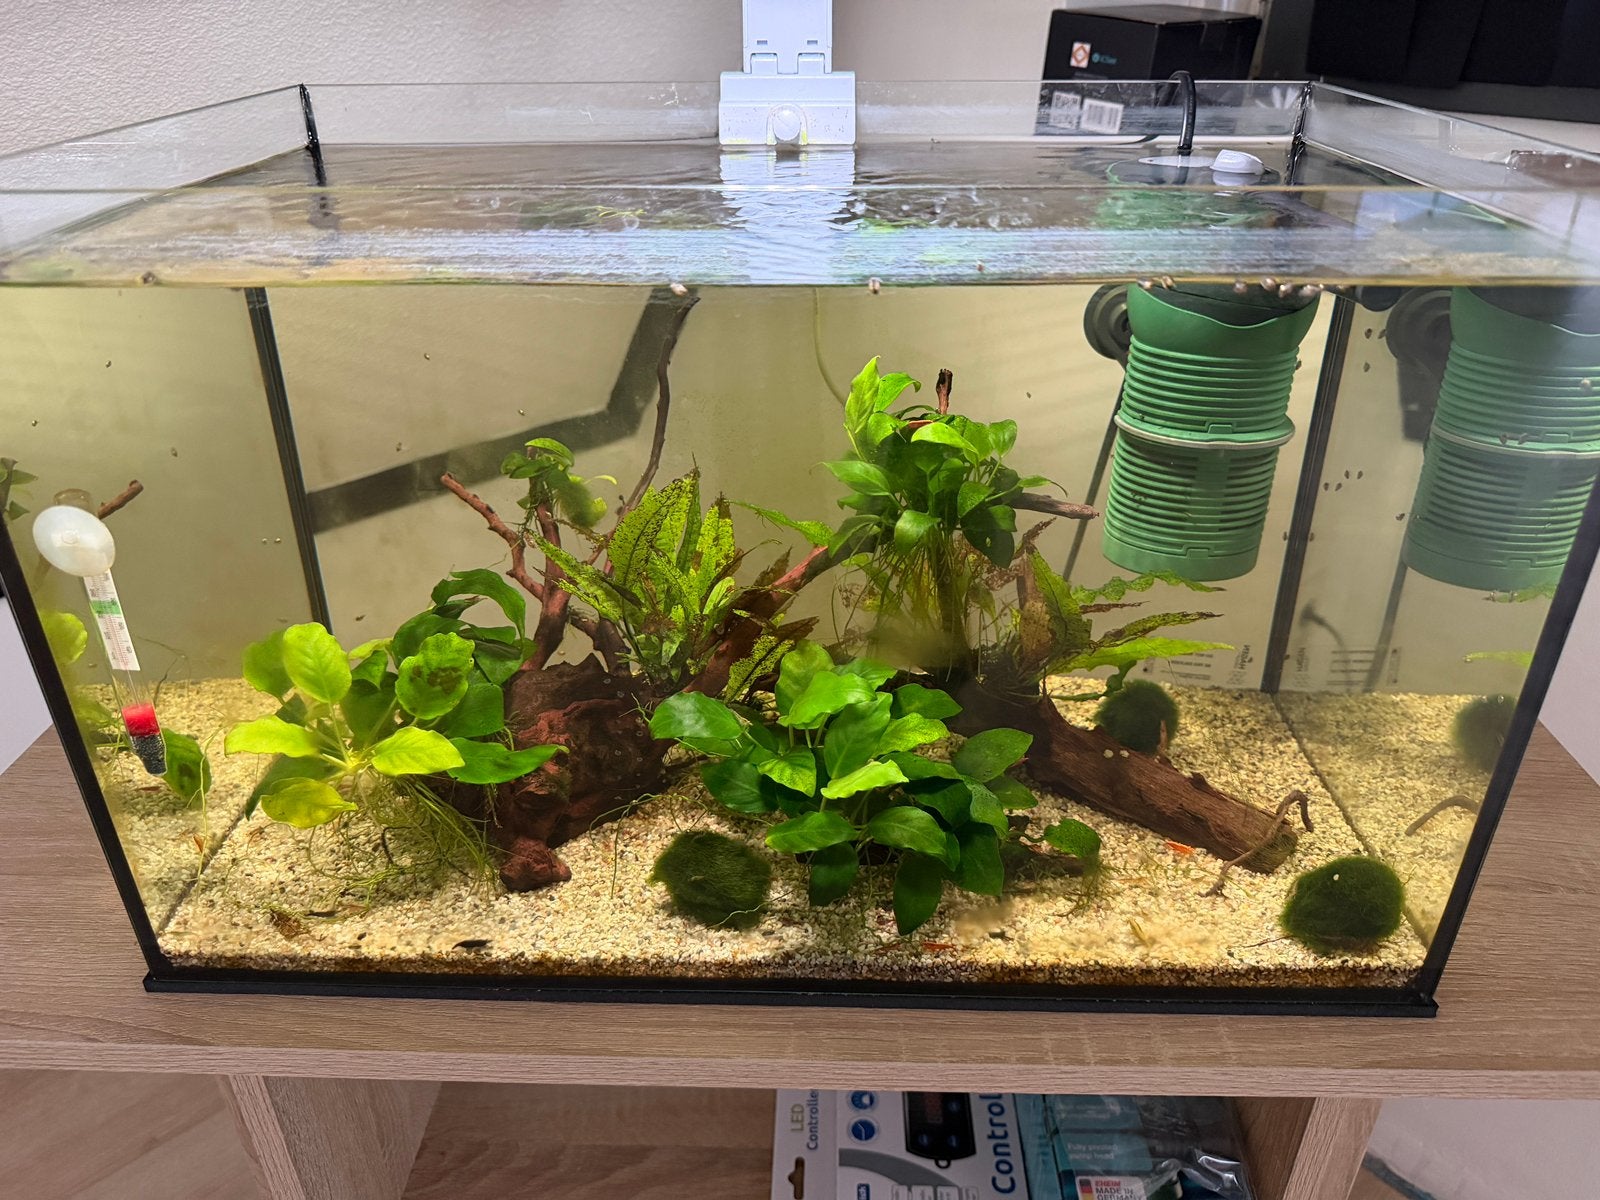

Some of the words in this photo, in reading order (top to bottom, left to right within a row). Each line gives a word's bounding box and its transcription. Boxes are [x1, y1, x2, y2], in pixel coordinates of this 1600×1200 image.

[790, 1103, 804, 1132] LED
[806, 1089, 819, 1151] Controlle
[979, 1092, 1016, 1194] Control
[1096, 1187, 1120, 1195] MADE
